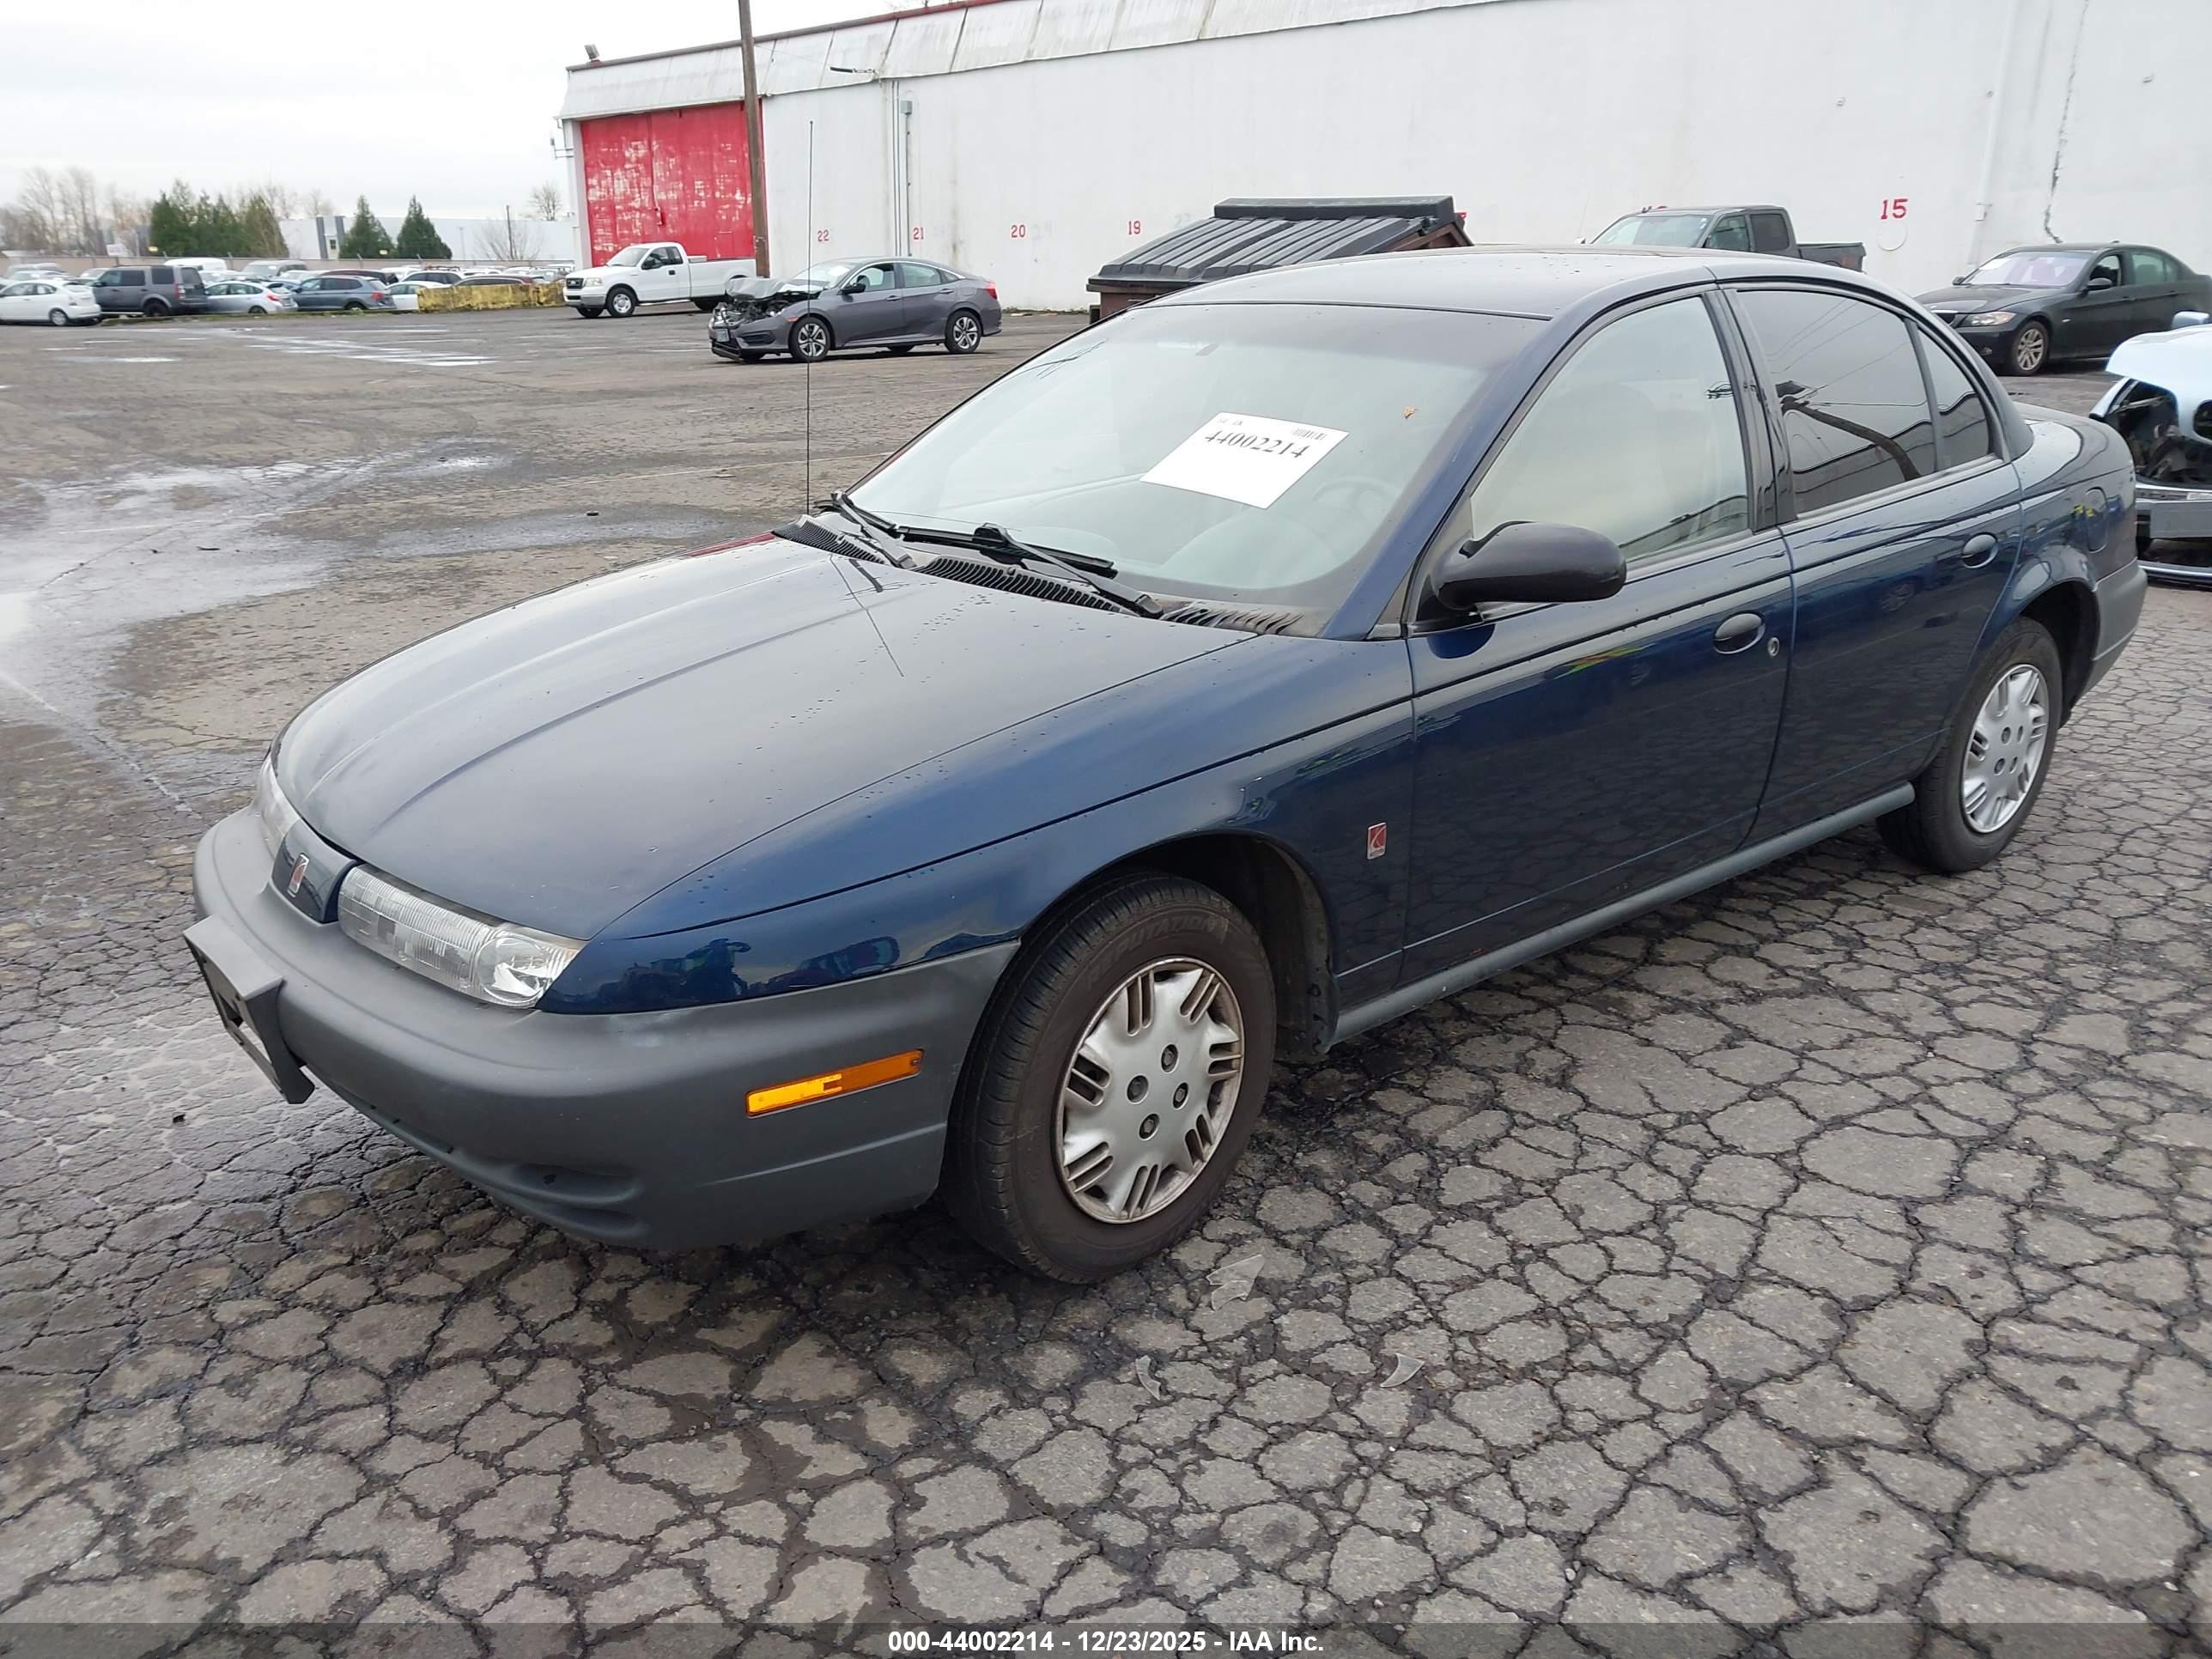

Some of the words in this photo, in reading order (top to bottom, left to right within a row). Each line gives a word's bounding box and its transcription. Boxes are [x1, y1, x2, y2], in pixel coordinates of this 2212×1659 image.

[1881, 198, 1908, 220] 15
[913, 228, 925, 240] 21
[1011, 224, 1026, 238] 20
[1127, 220, 1141, 235] 19
[817, 229, 830, 242] 22
[1204, 429, 1311, 459] 44002214
